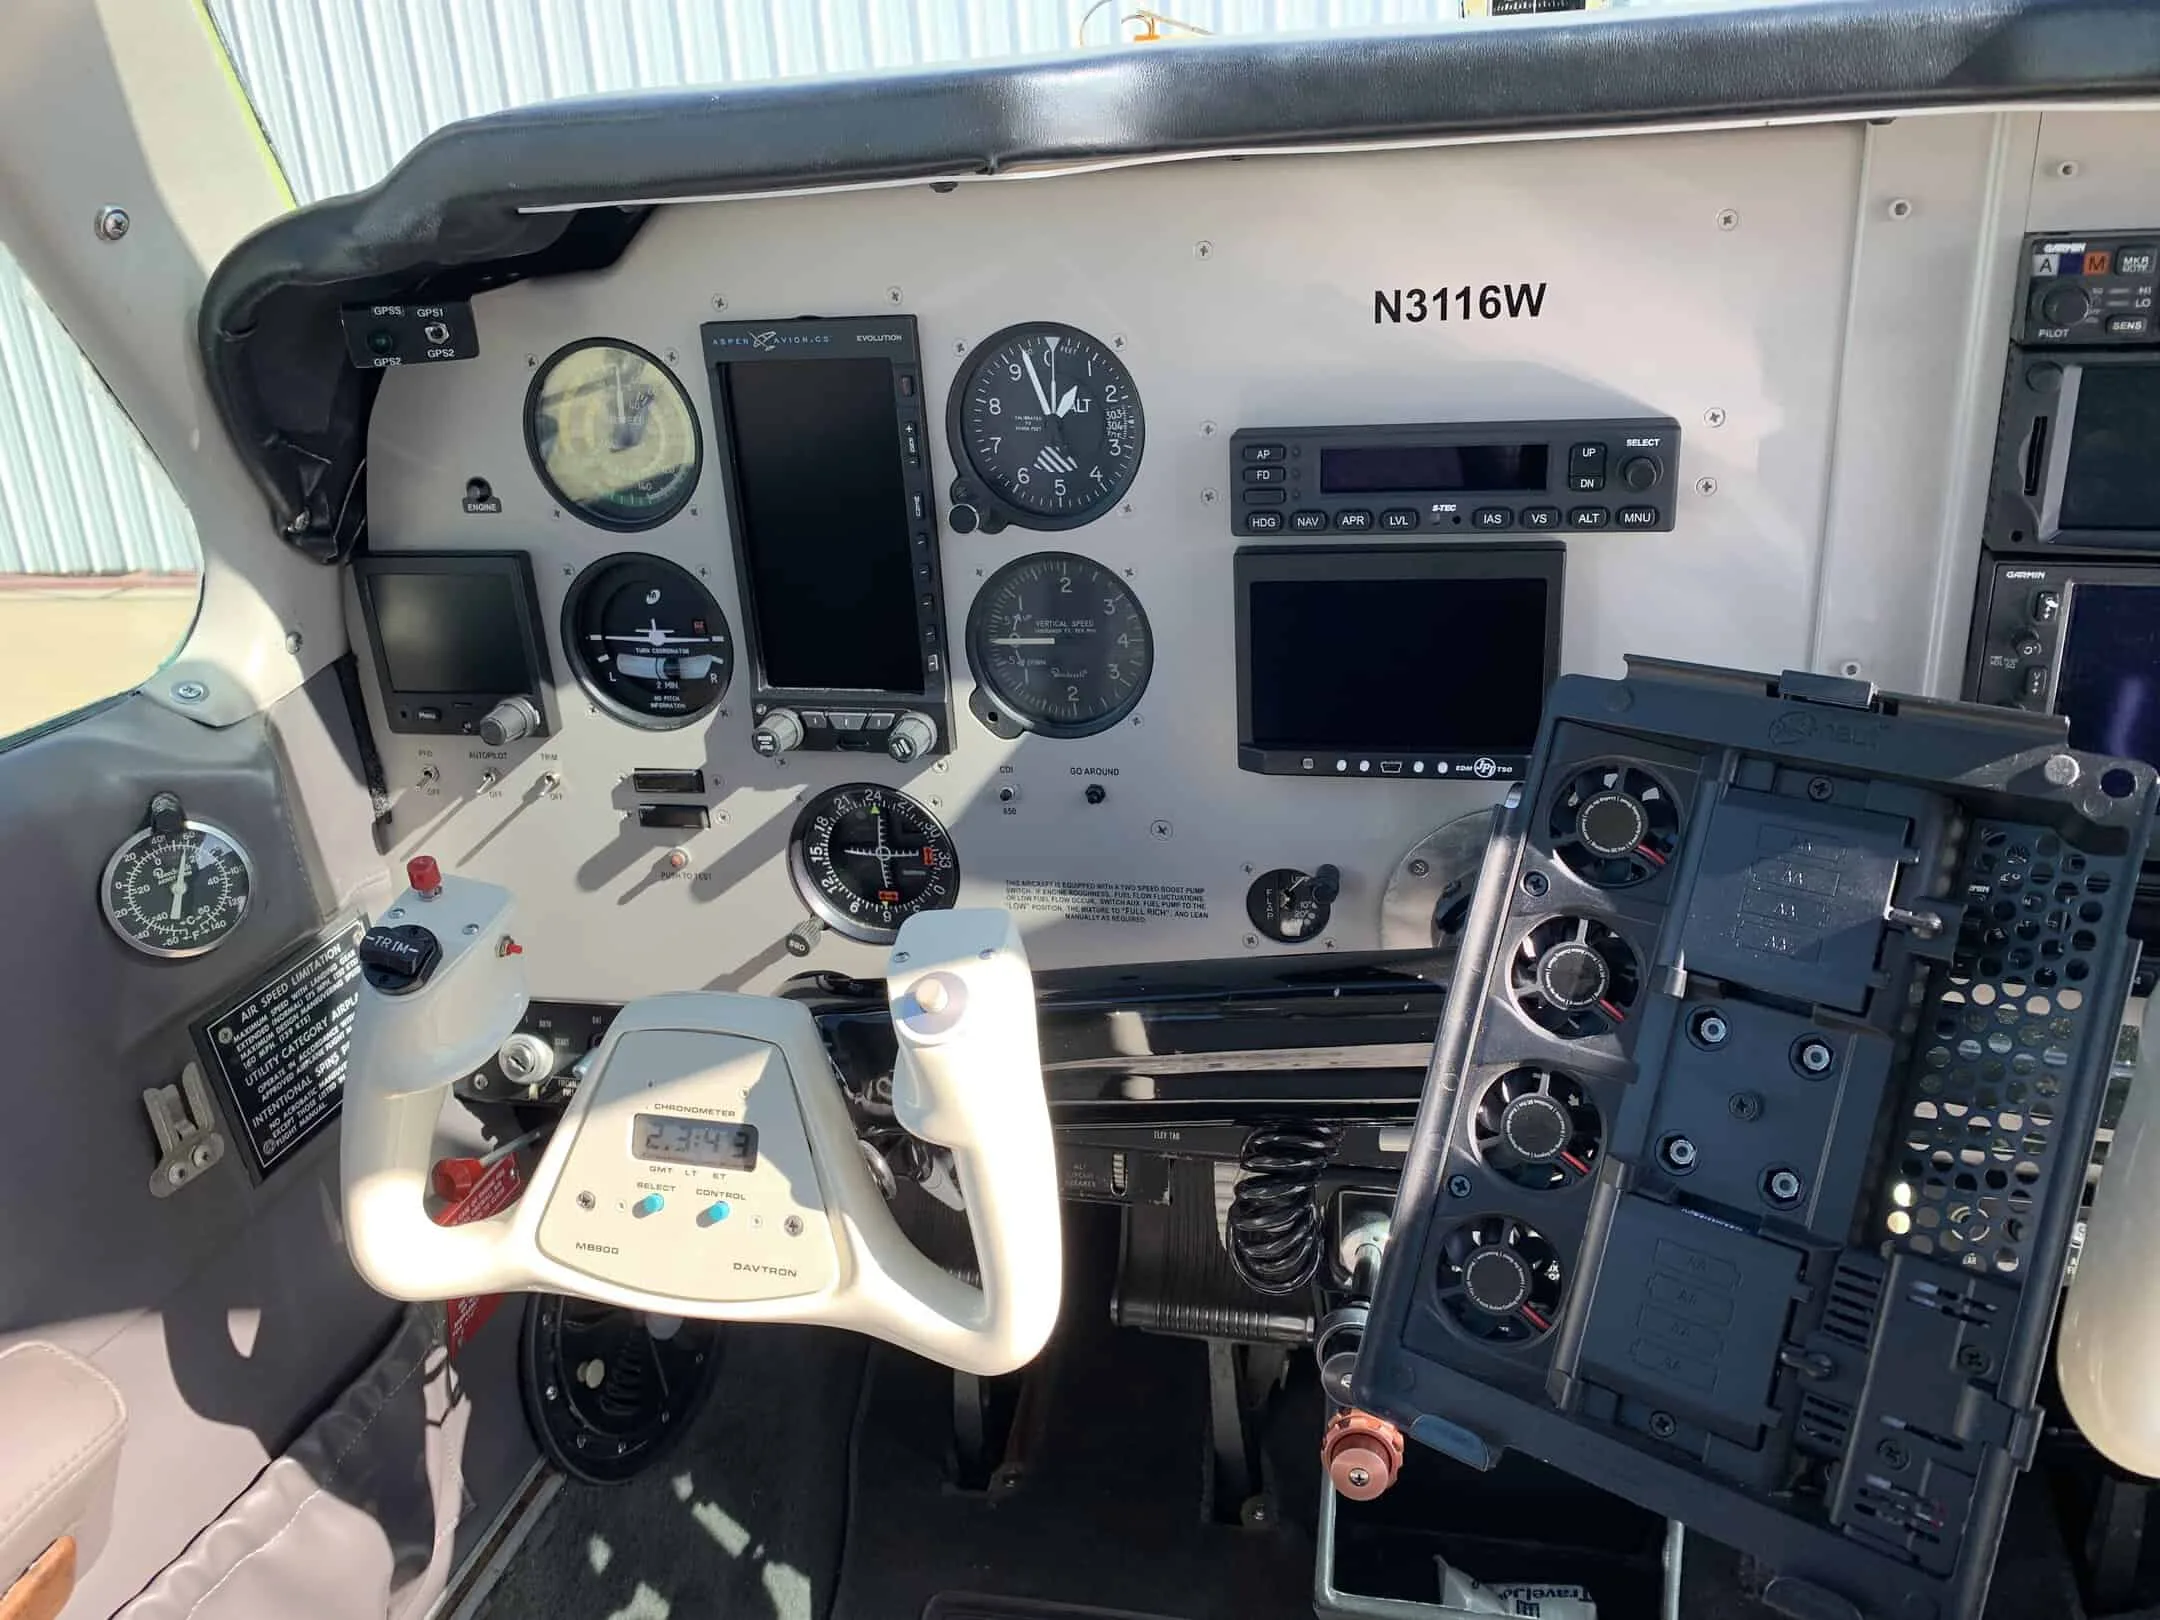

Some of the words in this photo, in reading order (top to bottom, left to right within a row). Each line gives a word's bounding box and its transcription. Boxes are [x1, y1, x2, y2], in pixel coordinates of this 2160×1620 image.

[2040, 258, 2052, 272] A
[2088, 258, 2104, 270] M
[1374, 282, 1547, 324] N3116W
[2136, 298, 2152, 308] LO
[417, 308, 444, 318] GPS1
[2112, 321, 2142, 330] SENS
[856, 334, 902, 342] EVOLUTION
[2038, 329, 2070, 338] PILOT
[712, 338, 750, 346] ASPEN
[427, 348, 455, 358] GPS2
[374, 357, 402, 367] GPS2
[1008, 364, 1022, 380] 9
[1104, 385, 1118, 402] 2
[989, 398, 1001, 415] 8
[990, 437, 1002, 454] 7
[1109, 439, 1121, 456] 3
[1626, 438, 1660, 448] SELECT
[1256, 450, 1270, 460] AP
[1582, 448, 1596, 457] UP
[1018, 468, 1030, 484] 6
[1090, 466, 1104, 482] 4
[1256, 470, 1270, 480] FD
[1054, 480, 1066, 496] 5
[1580, 479, 1594, 488] DN
[467, 503, 497, 512] ENGINE
[1432, 504, 1457, 512] S-TEC
[1252, 518, 1276, 528] HDG
[1297, 518, 1319, 526] NAV
[1342, 516, 1364, 526] APR
[1389, 516, 1408, 526] LVL
[1484, 514, 1502, 524] IAS
[1532, 514, 1548, 524] VS
[1578, 514, 1600, 524] ALT
[1624, 513, 1651, 523] MNU
[2006, 571, 2046, 580] GARMIN
[1060, 577, 1072, 593] 2
[1104, 600, 1116, 615] 3
[1117, 632, 1129, 648] 4
[608, 672, 616, 682] L
[1108, 664, 1120, 680] 3
[710, 674, 718, 684] R
[1067, 686, 1080, 702] 2
[469, 752, 508, 760] AUTOPILOT
[1000, 766, 1014, 774] CDI
[1070, 768, 1082, 776] GO
[1084, 768, 1120, 776] AROUND
[864, 789, 882, 801] 24
[834, 795, 850, 810] 21
[814, 816, 828, 832] 18
[924, 822, 942, 838] 30
[183, 832, 196, 840] 60
[124, 852, 136, 862] 20
[809, 846, 824, 863] 15
[154, 858, 162, 866] 0
[938, 852, 952, 869] 33
[116, 882, 122, 890] 0
[207, 876, 220, 886] 40
[822, 878, 839, 894] 12
[186, 916, 196, 925] C
[211, 920, 226, 931] 140
[192, 930, 200, 940] F
[374, 936, 412, 955] TRIM
[241, 1004, 259, 1022] AIR
[260, 982, 289, 1008] SPEED
[290, 944, 342, 986] LIMITATION
[233, 1014, 269, 1043] MAXIMUM
[270, 999, 290, 1017] SPEED
[290, 984, 308, 1000] WITH
[236, 1024, 270, 1054] EXTENDED
[240, 1032, 274, 1060] MAXIMUM
[276, 1012, 300, 1034] DESIGN
[244, 1054, 280, 1087] UTILITY
[281, 1015, 328, 1058] CATEGORY
[258, 1068, 286, 1094] OPERATE
[298, 1024, 340, 1062] ACCORDANCE
[252, 1075, 312, 1128] INTENTIONAL
[314, 1051, 340, 1078] SPINS
[261, 1072, 295, 1102] APPROVED
[268, 1118, 280, 1130] NO
[283, 1086, 318, 1120] ACROBATIC
[654, 1103, 736, 1117] CHRONOMETER
[272, 1116, 294, 1138] EXCEPT
[296, 1098, 318, 1118] THOSE
[276, 1124, 298, 1147] FLIGHT
[649, 1166, 673, 1174] GMT
[712, 1172, 727, 1180] ET
[636, 1182, 677, 1192] SELECT
[696, 1188, 747, 1200] CONTROL
[732, 1262, 798, 1278] DAVTRON
